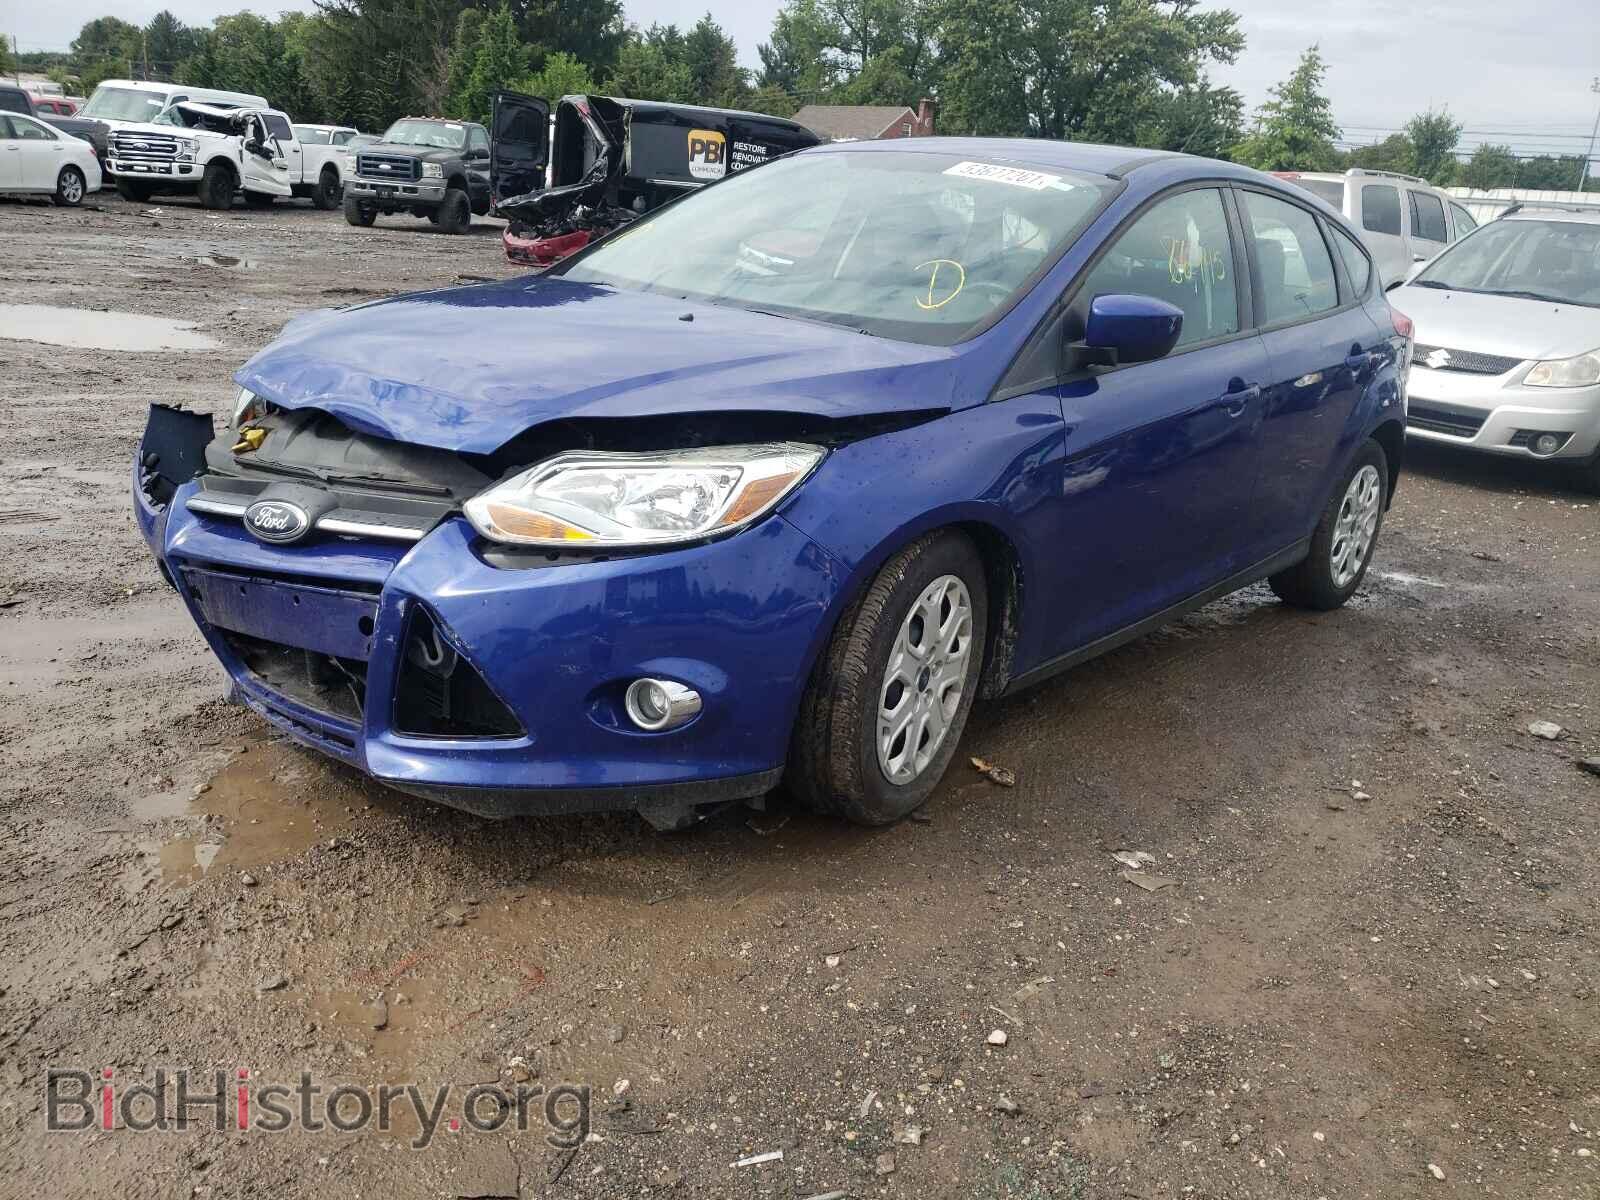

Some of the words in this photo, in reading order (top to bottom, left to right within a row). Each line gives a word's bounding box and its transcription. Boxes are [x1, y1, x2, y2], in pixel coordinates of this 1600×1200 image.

[733, 141, 767, 155] RESTORE
[913, 259, 965, 309] D
[254, 506, 290, 530] Ford
